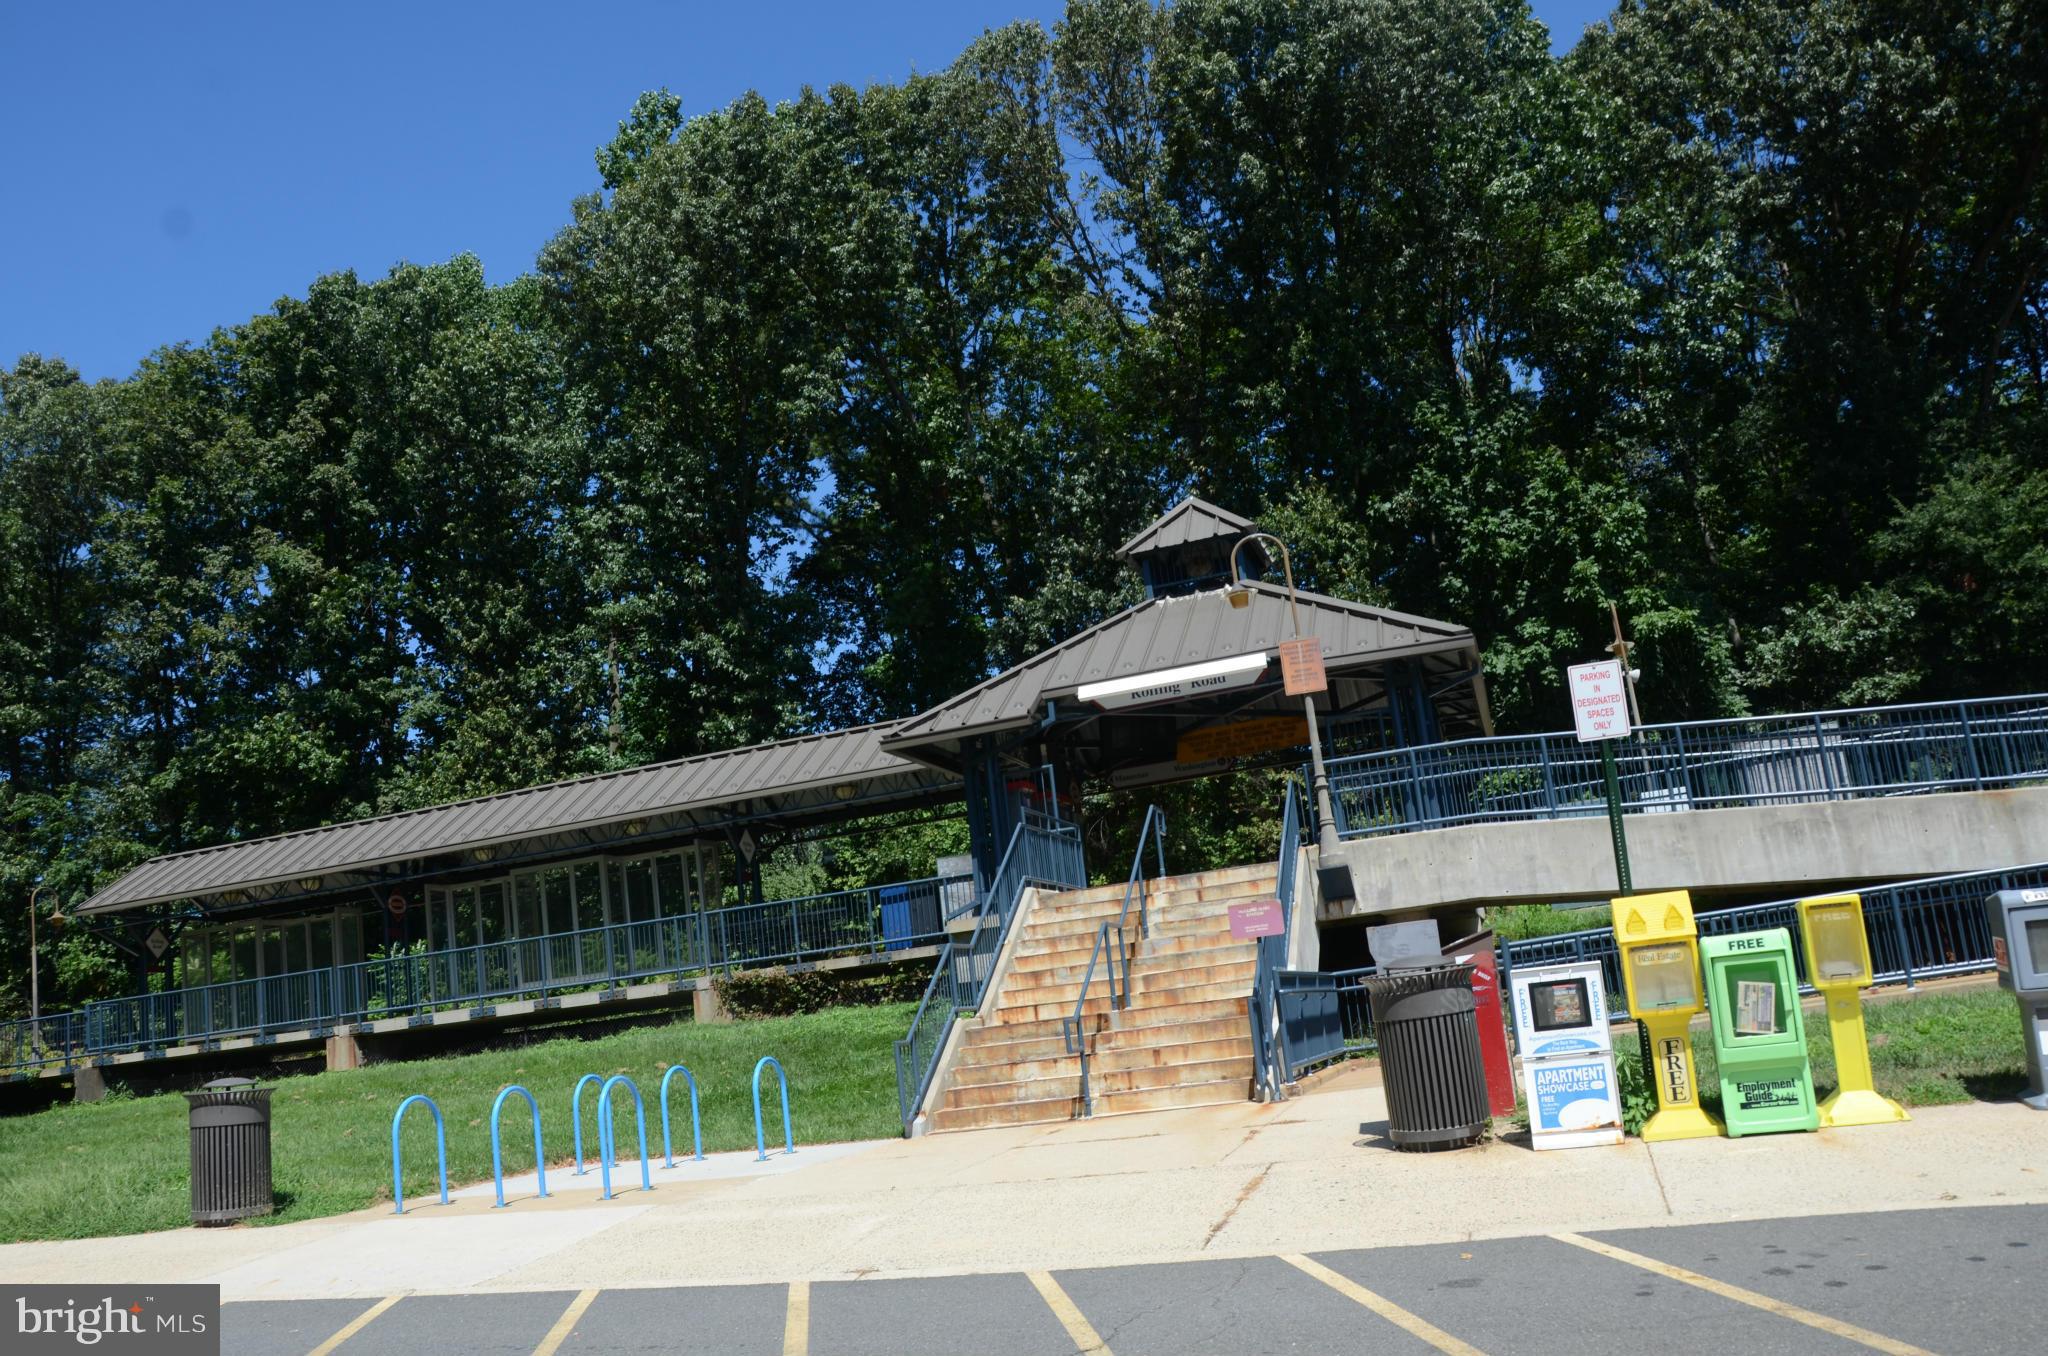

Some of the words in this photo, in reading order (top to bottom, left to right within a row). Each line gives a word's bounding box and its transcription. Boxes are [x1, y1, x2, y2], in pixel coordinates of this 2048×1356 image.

[1580, 670, 1611, 682] PARKING
[1593, 684, 1601, 693] IN
[1577, 694, 1621, 708] DESIGNATED
[1587, 707, 1615, 719] SPACES
[1593, 720, 1612, 731] ONLY
[1814, 911, 1851, 922] FREE
[1728, 937, 1765, 951] FREE
[1638, 952, 1655, 963] Real
[1657, 951, 1681, 961] Estate
[1591, 980, 1601, 1021] FREE
[1519, 988, 1529, 1028] FREE
[1537, 1065, 1604, 1085] APARTMENT
[1663, 1039, 1687, 1102] FREE
[1538, 1081, 1590, 1095] SHOWCASE
[1736, 1077, 1796, 1093] Employment
[1541, 1095, 1555, 1103] FREE
[1745, 1091, 1773, 1102] Guide
